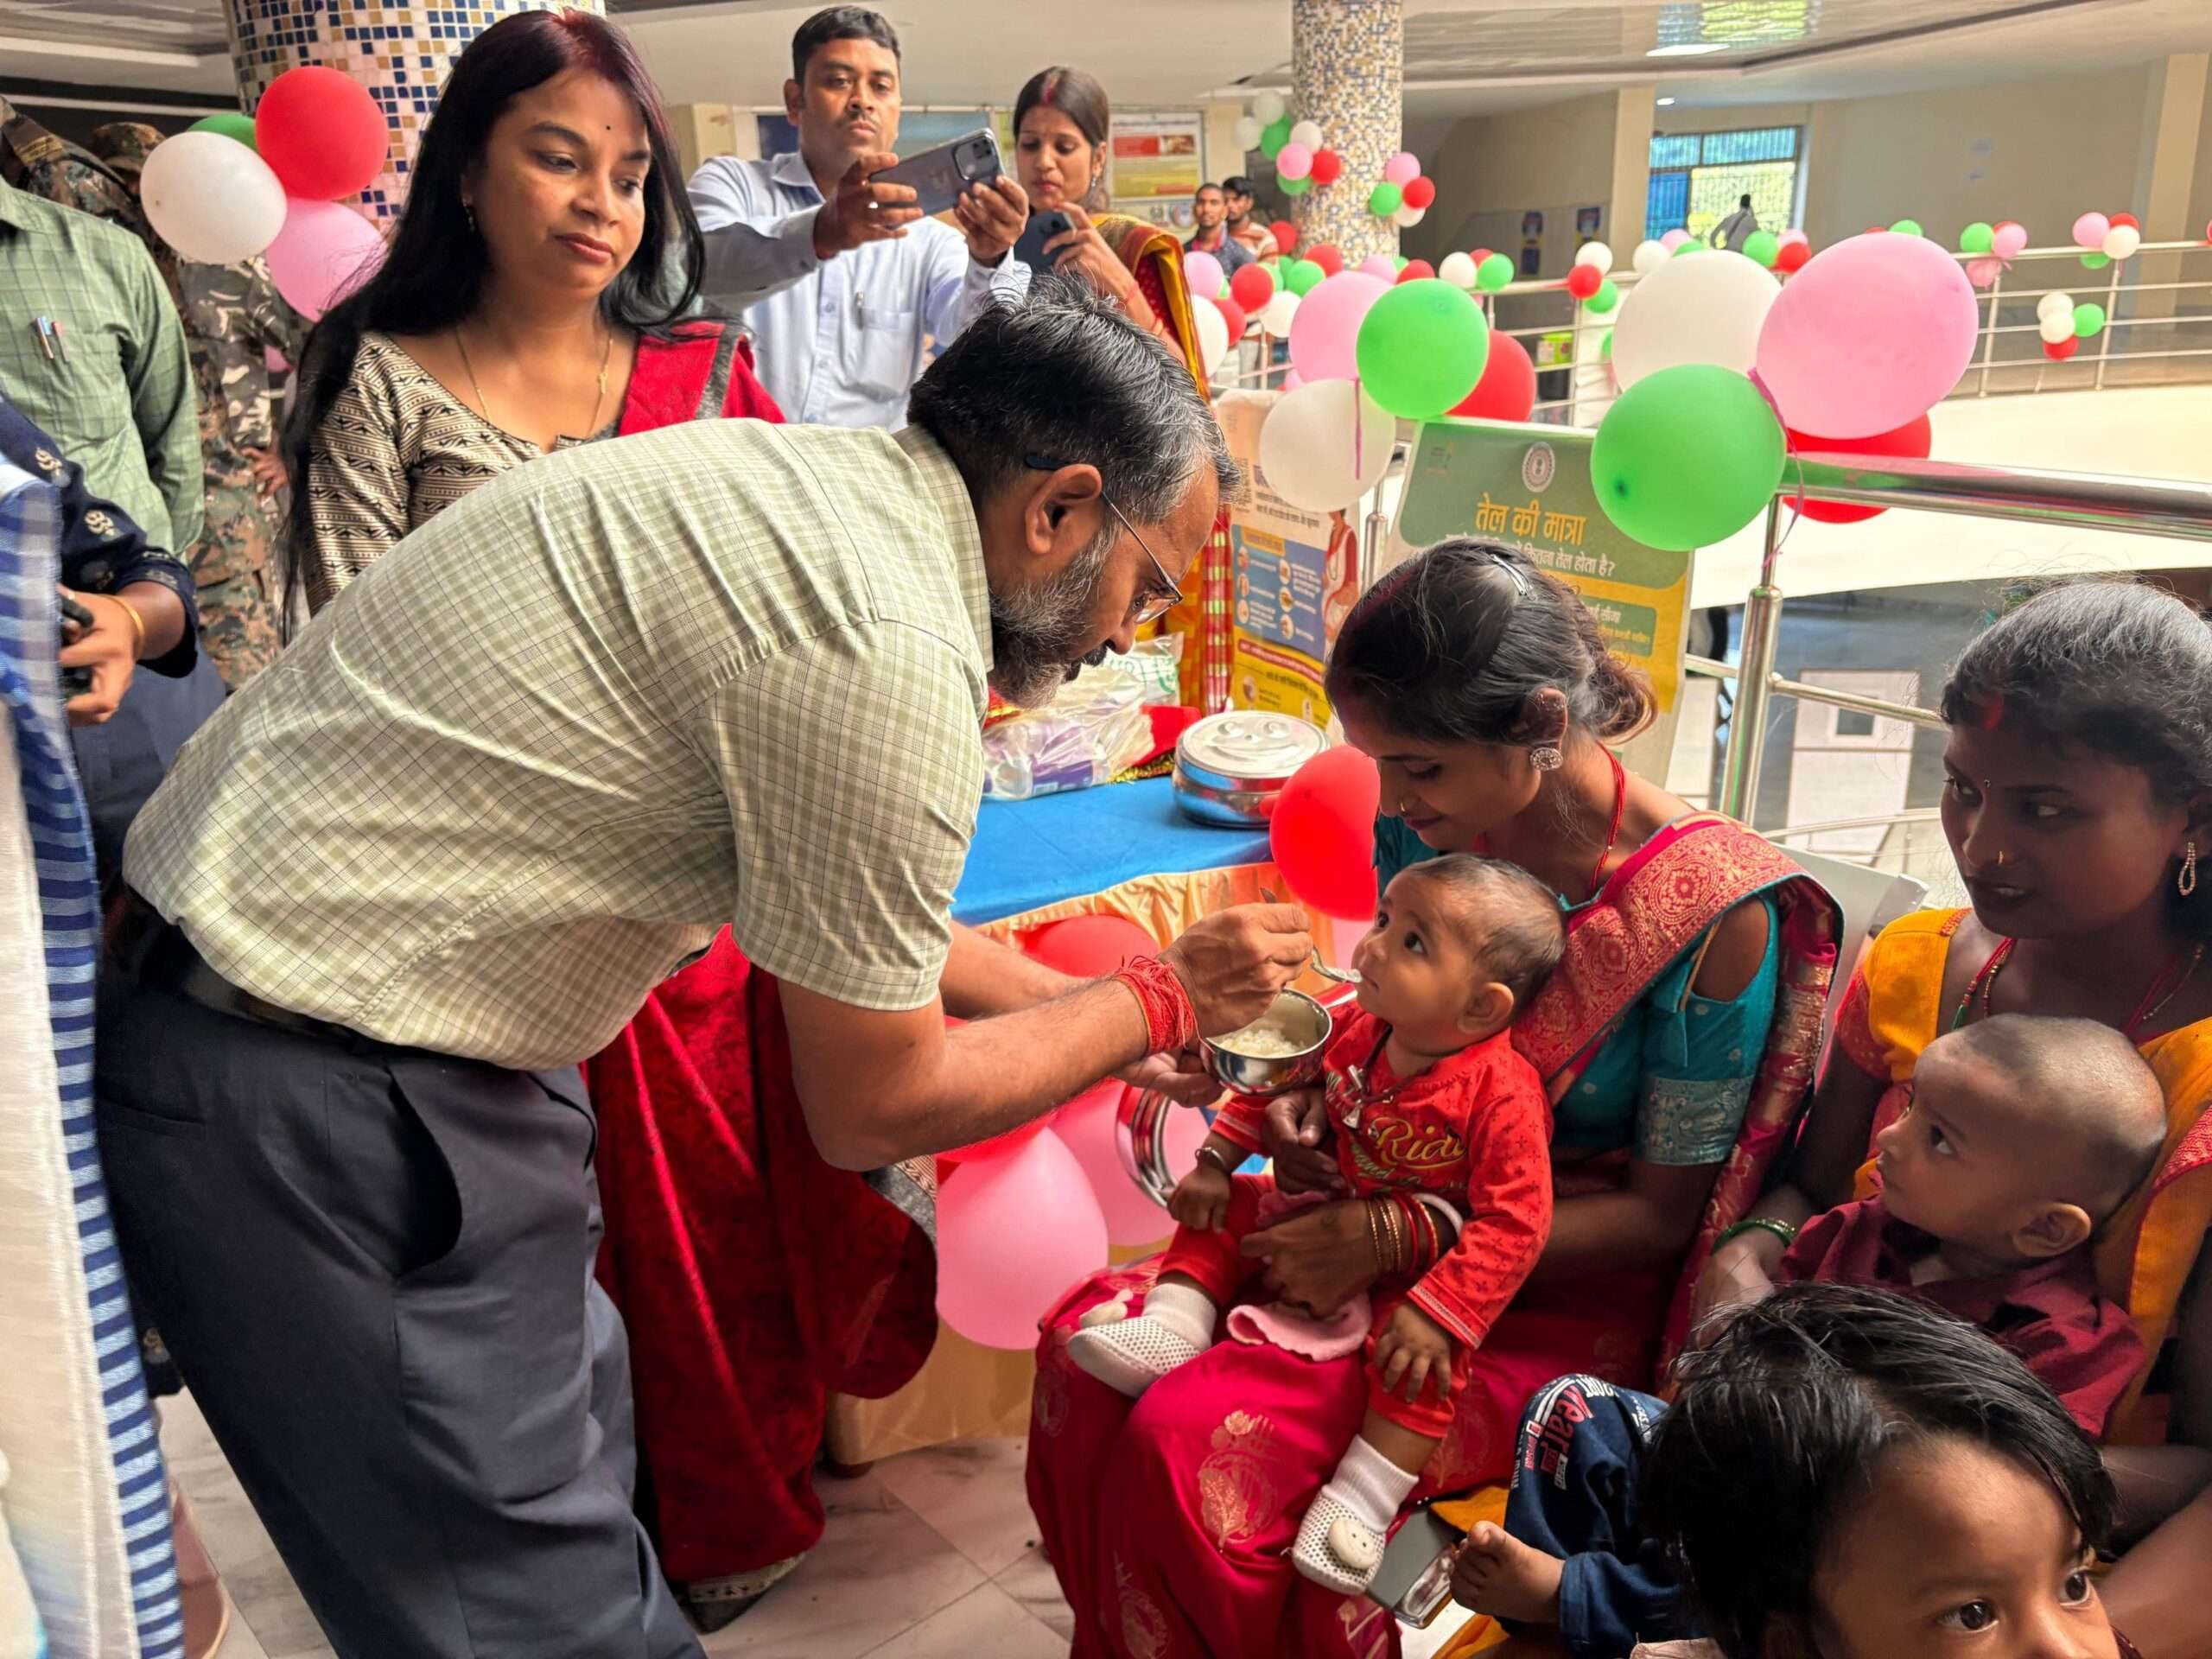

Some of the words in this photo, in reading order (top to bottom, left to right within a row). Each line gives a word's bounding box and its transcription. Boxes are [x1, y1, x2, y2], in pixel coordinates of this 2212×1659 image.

[1476, 493, 1509, 533] तेल
[1511, 499, 1541, 538] की
[1543, 512, 1586, 546] मात्रा
[1554, 547, 1573, 571] तेल
[1574, 550, 1598, 575] होता
[1598, 553, 1616, 577] है?
